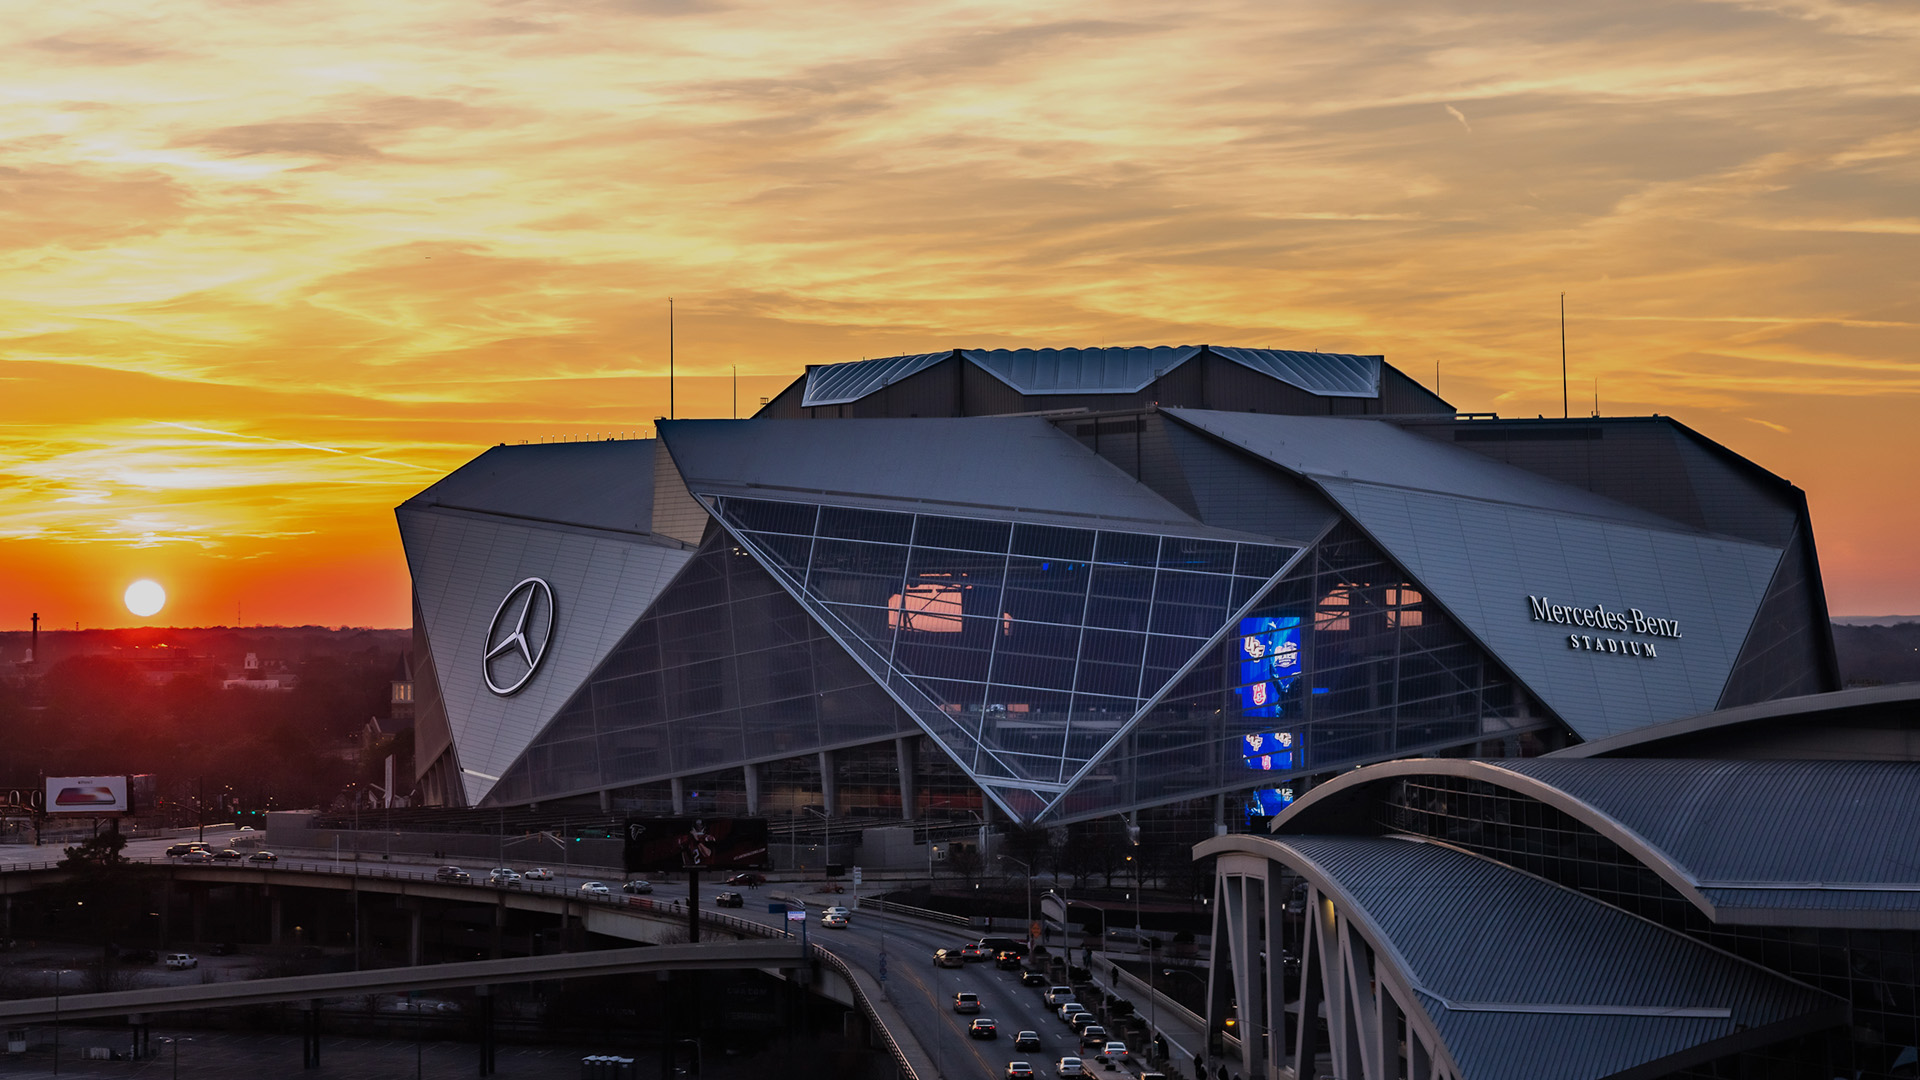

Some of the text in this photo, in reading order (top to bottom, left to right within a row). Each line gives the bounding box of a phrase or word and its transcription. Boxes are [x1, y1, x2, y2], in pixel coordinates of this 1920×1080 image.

[1528, 595, 1682, 638] Mercedes-Benz
[1244, 636, 1266, 663] UCF
[1570, 634, 1657, 658] STADIUM
